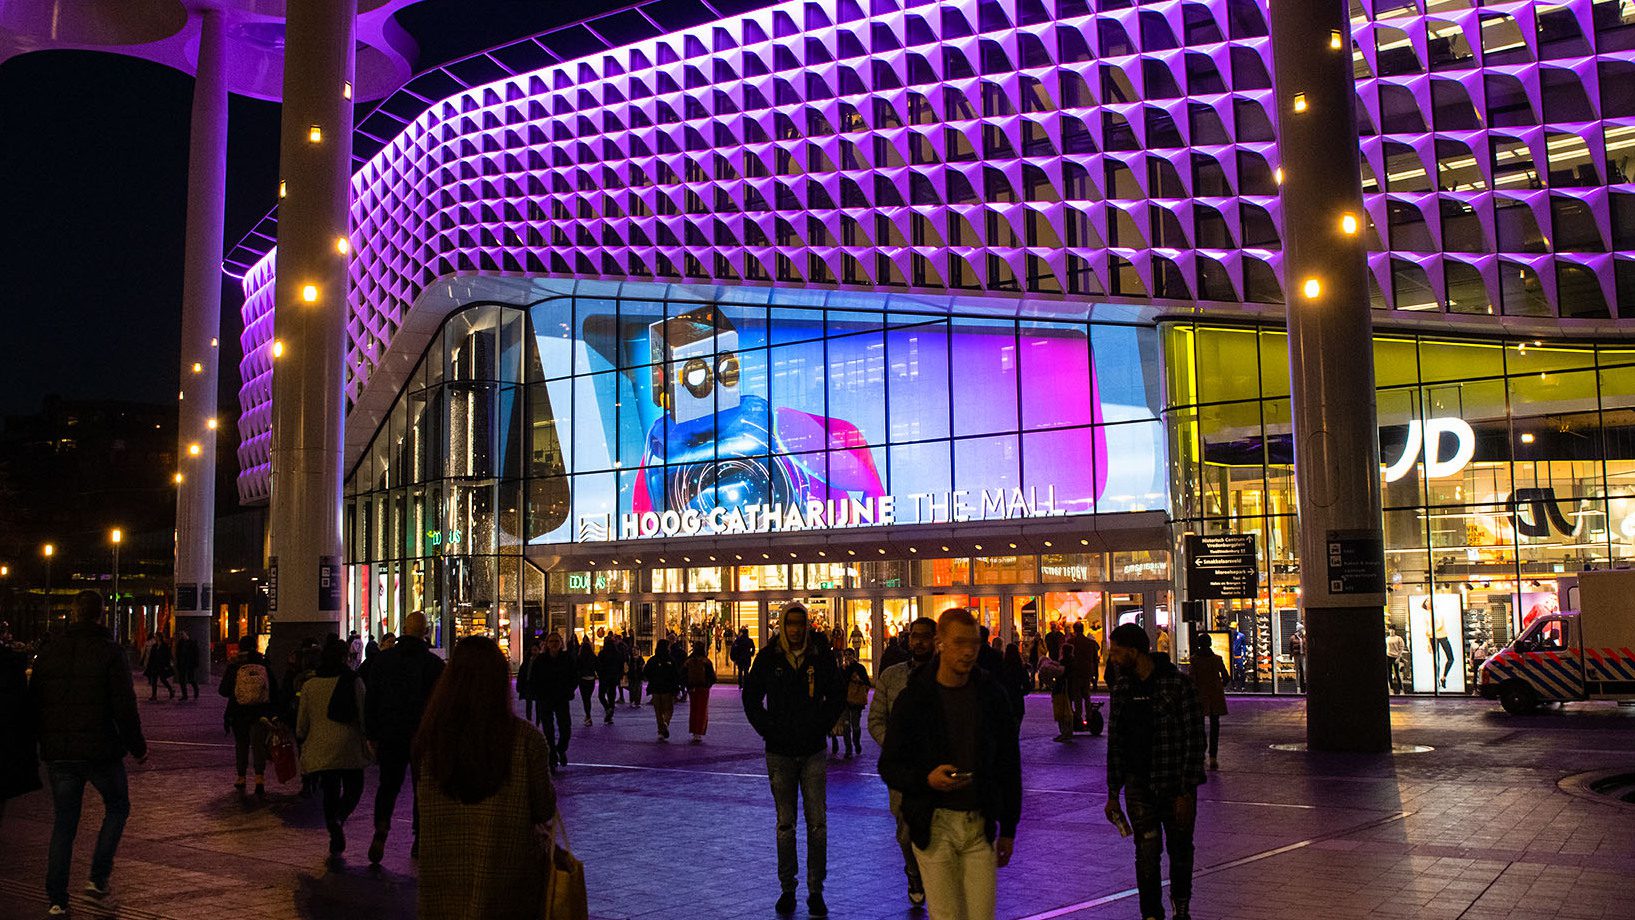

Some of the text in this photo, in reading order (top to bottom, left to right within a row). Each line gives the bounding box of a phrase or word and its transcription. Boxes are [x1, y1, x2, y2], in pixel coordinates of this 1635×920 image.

[1385, 417, 1475, 483] JD
[621, 485, 1067, 539] HOOG CATHARIJNE THE MALL
